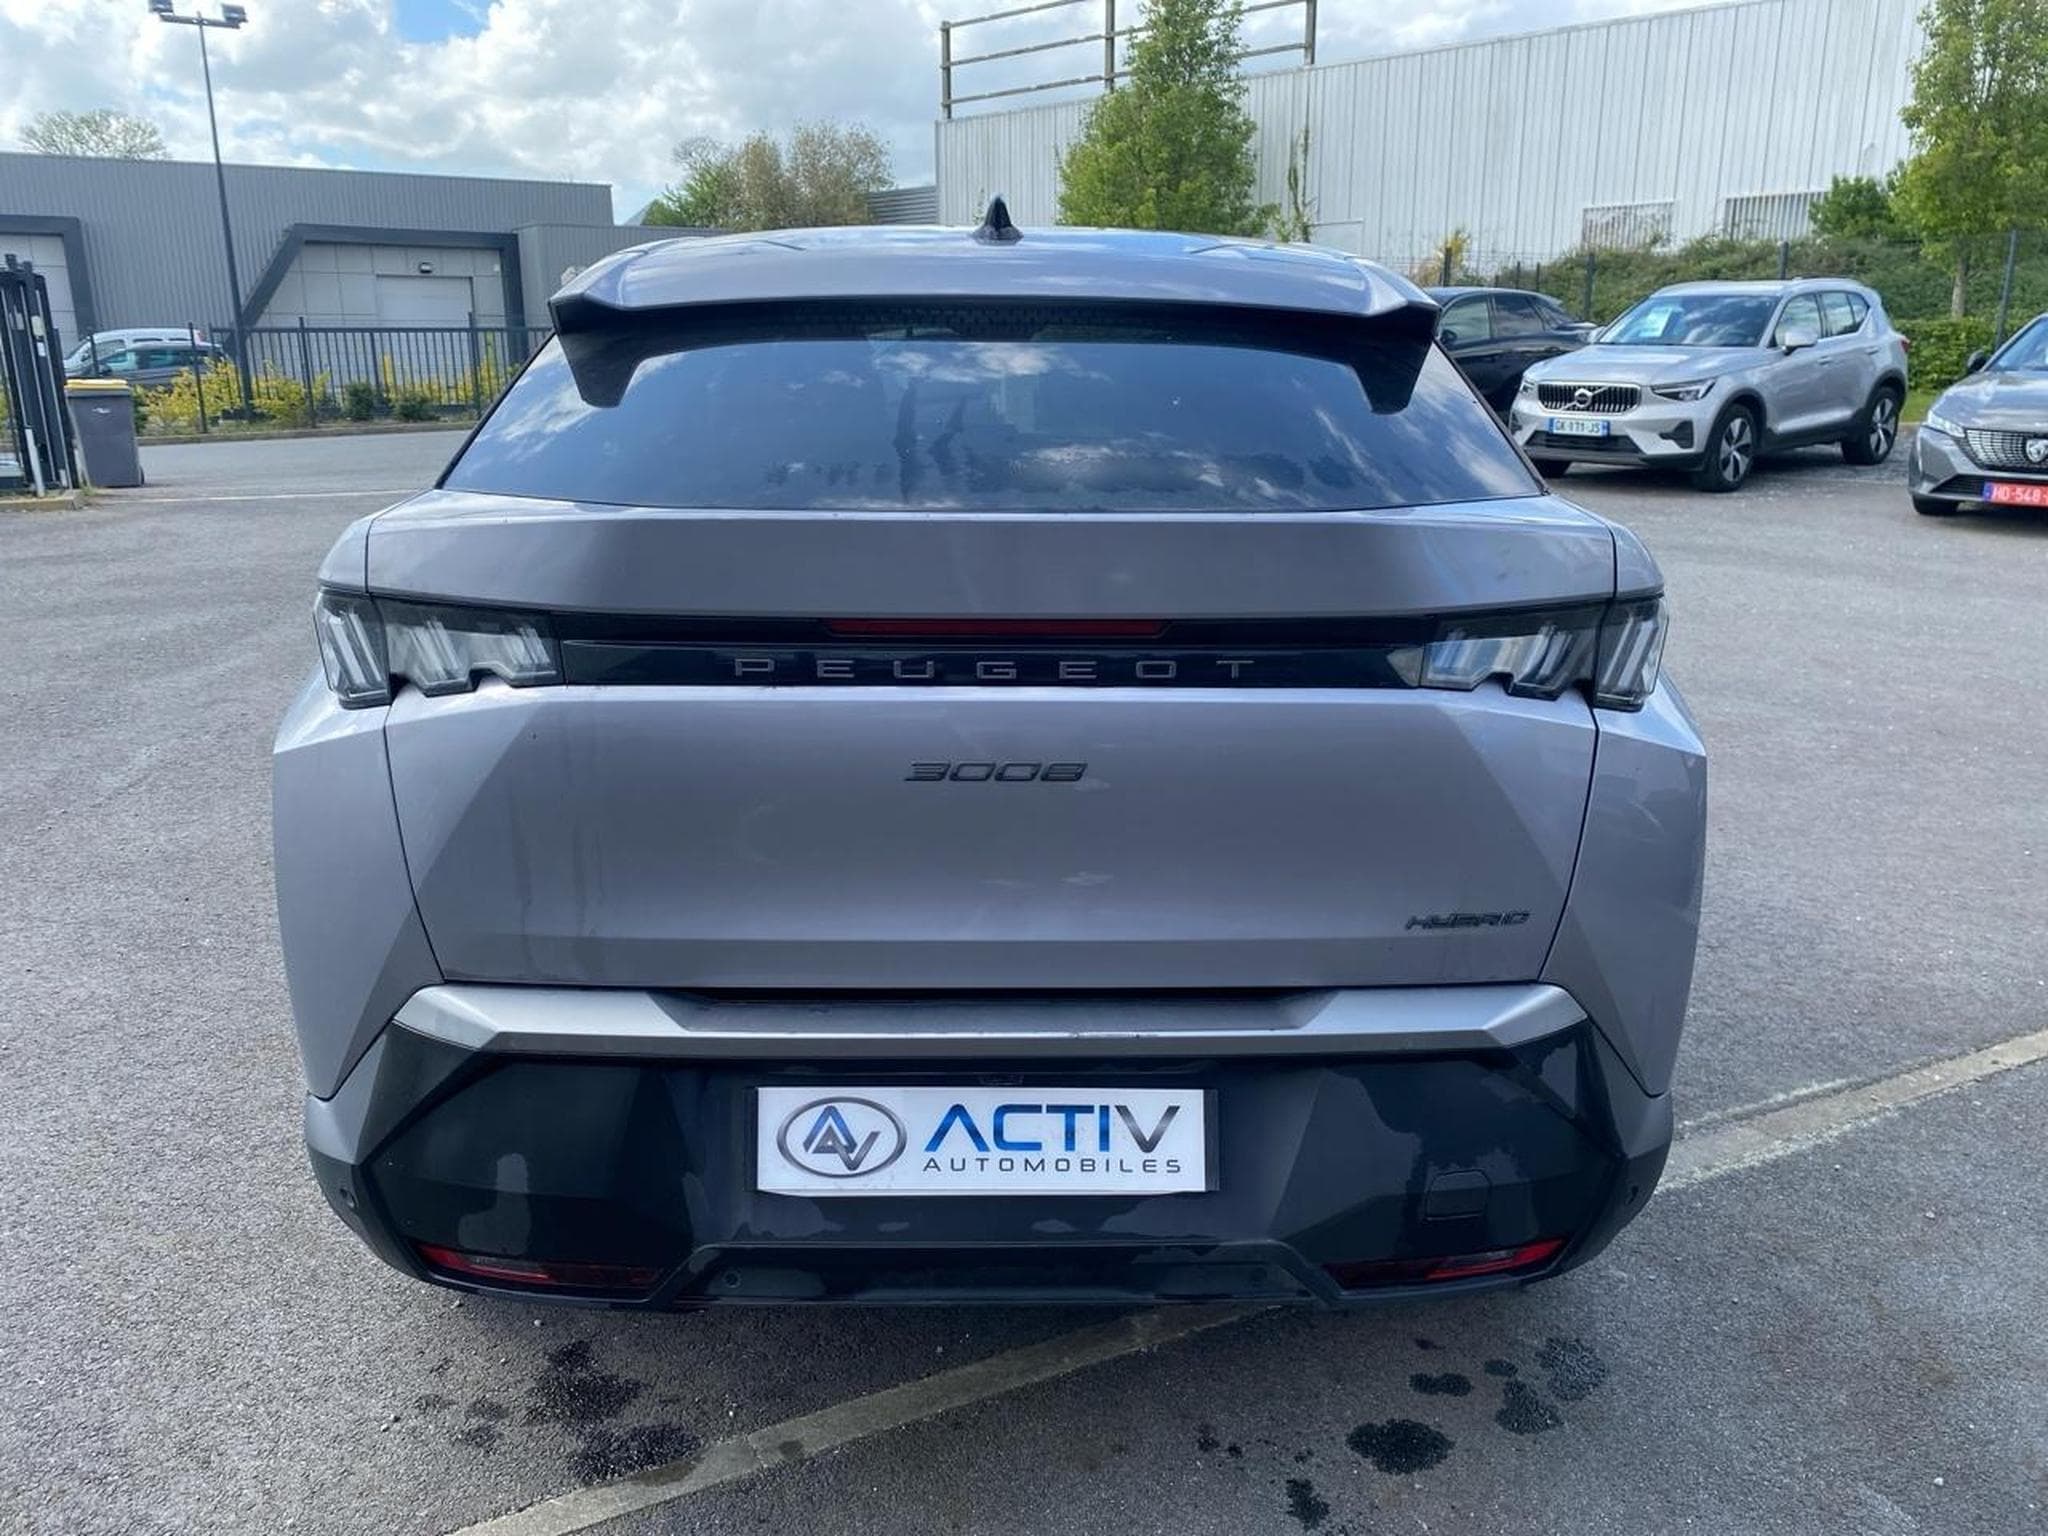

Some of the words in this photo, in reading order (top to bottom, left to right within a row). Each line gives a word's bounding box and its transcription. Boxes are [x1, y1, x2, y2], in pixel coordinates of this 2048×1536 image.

[734, 657, 1255, 680] PEUGEOT
[904, 760, 1089, 783] 3008
[1405, 910, 1531, 931] HYBRID
[923, 1103, 1181, 1154] ACTIV
[922, 1157, 1182, 1175] AUTOMOBILES
